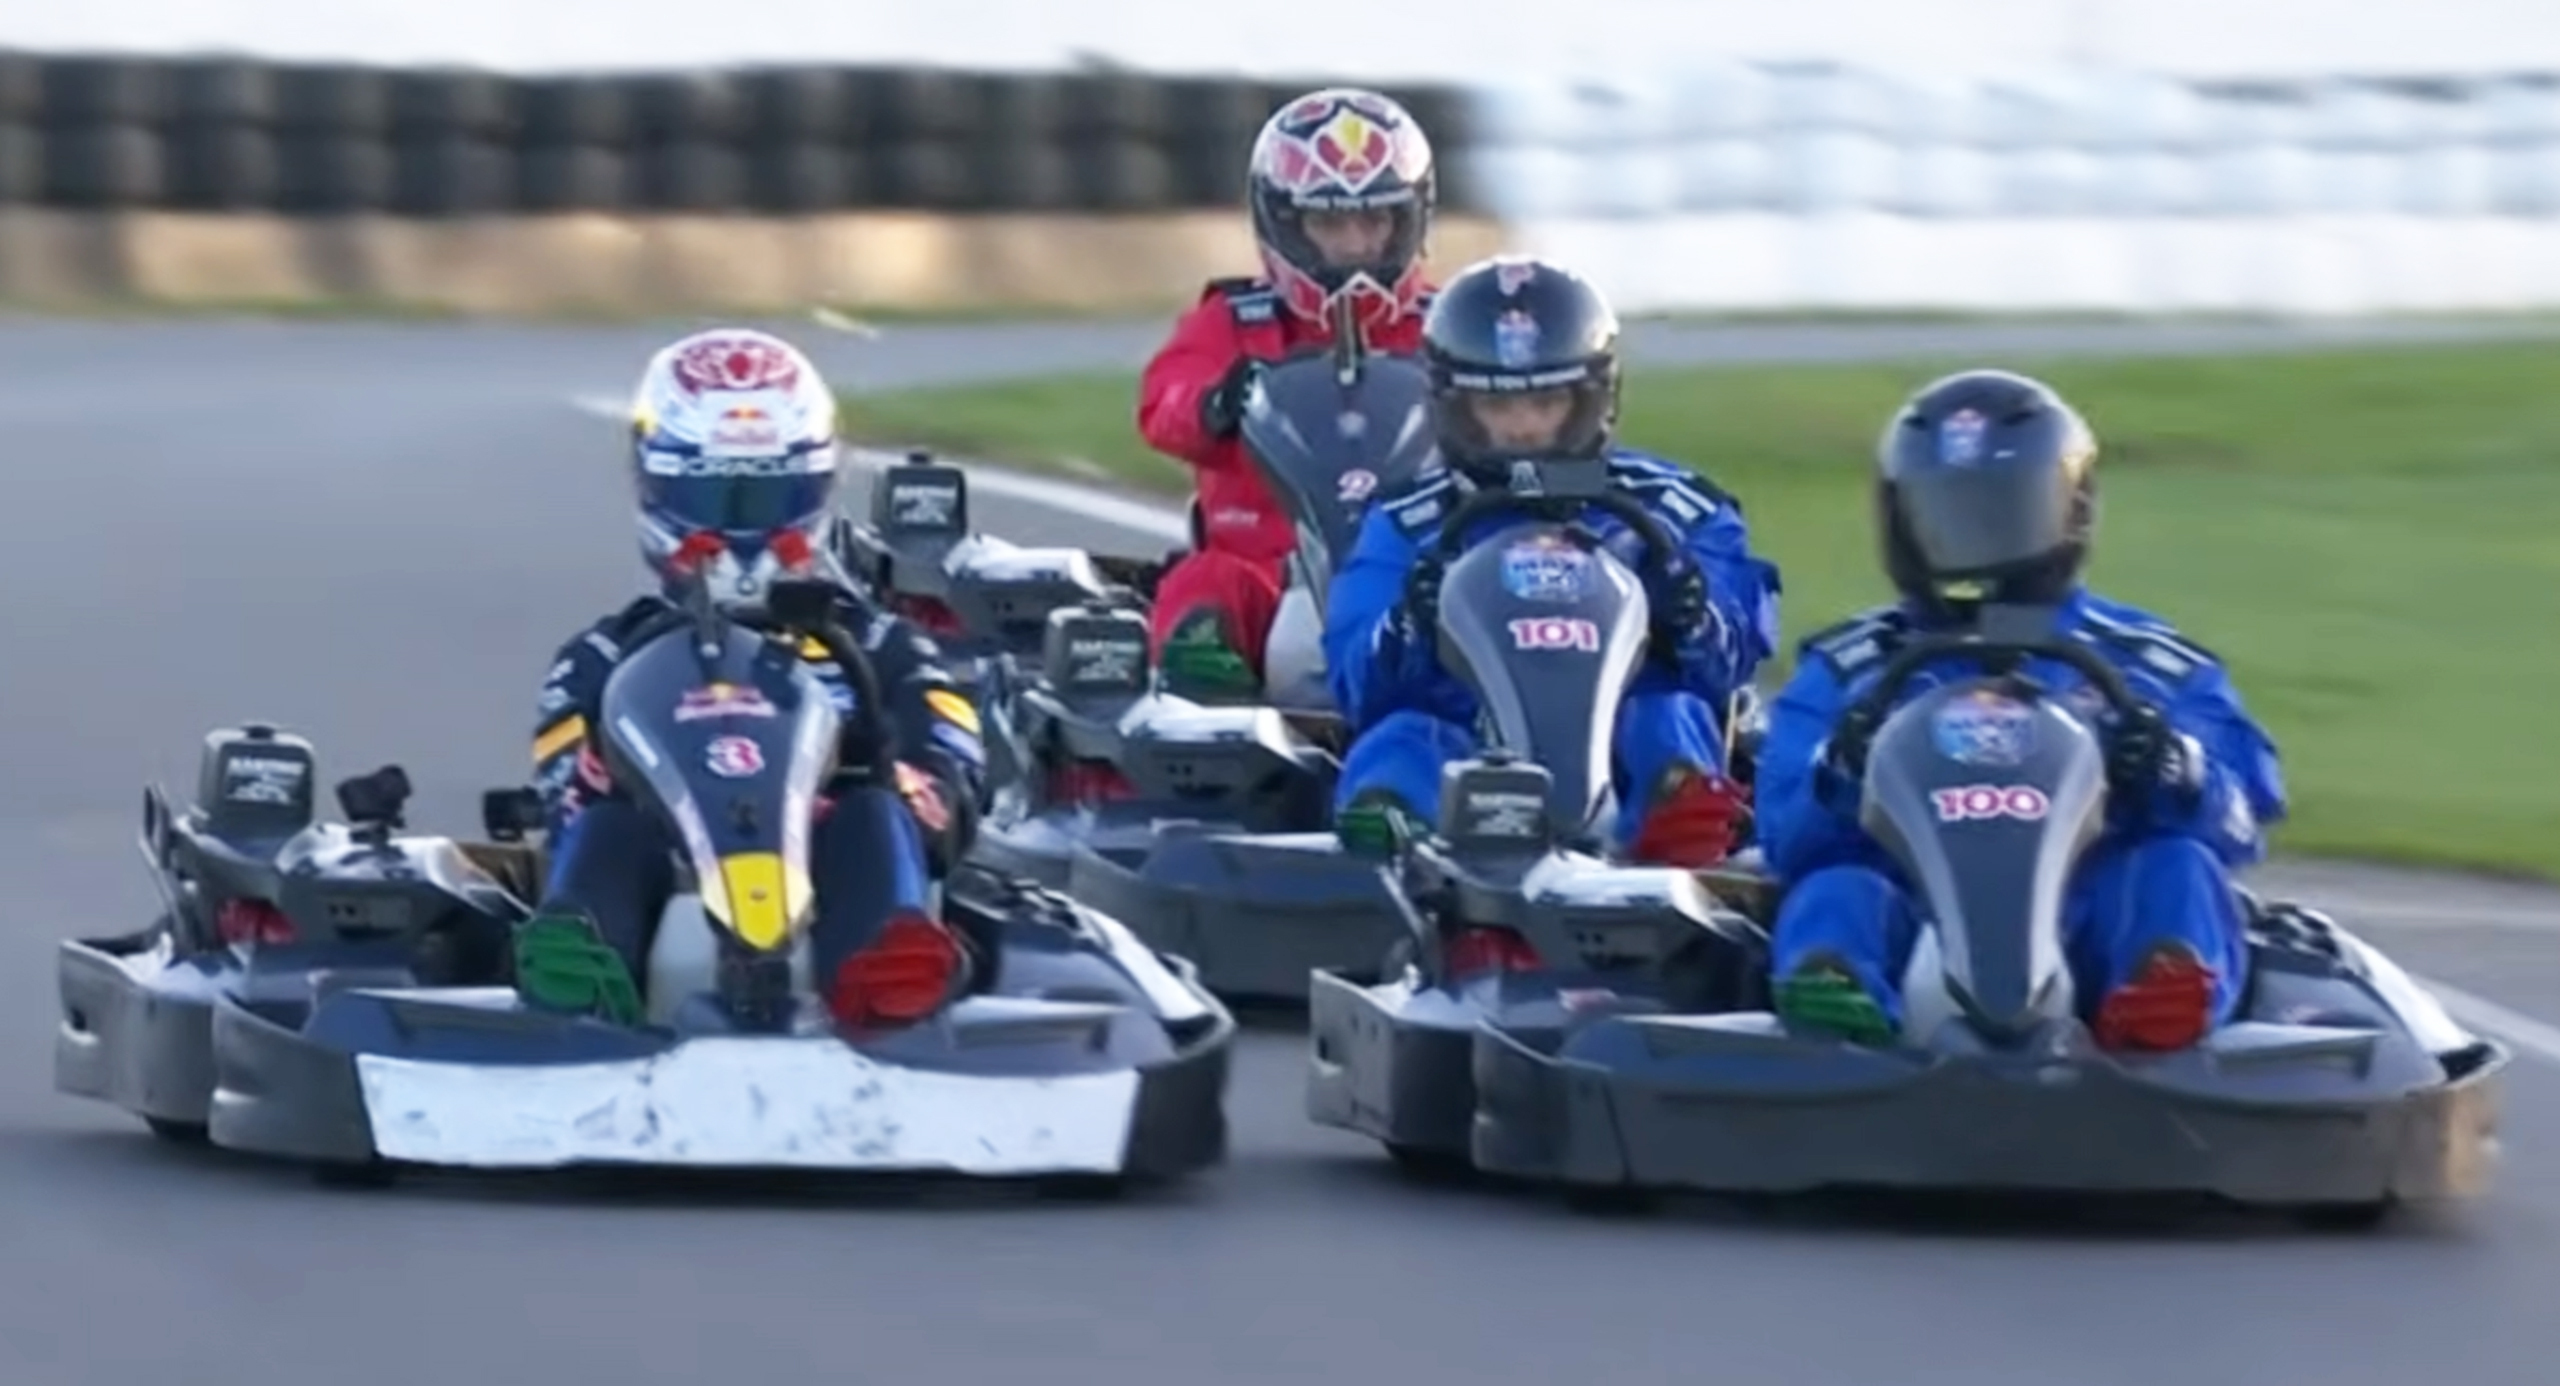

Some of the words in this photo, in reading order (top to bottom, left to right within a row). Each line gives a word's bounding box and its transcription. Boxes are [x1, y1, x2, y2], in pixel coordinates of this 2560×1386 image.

[1508, 617, 1599, 653] 101
[706, 734, 766, 778] 3
[1929, 782, 2050, 822] 100
